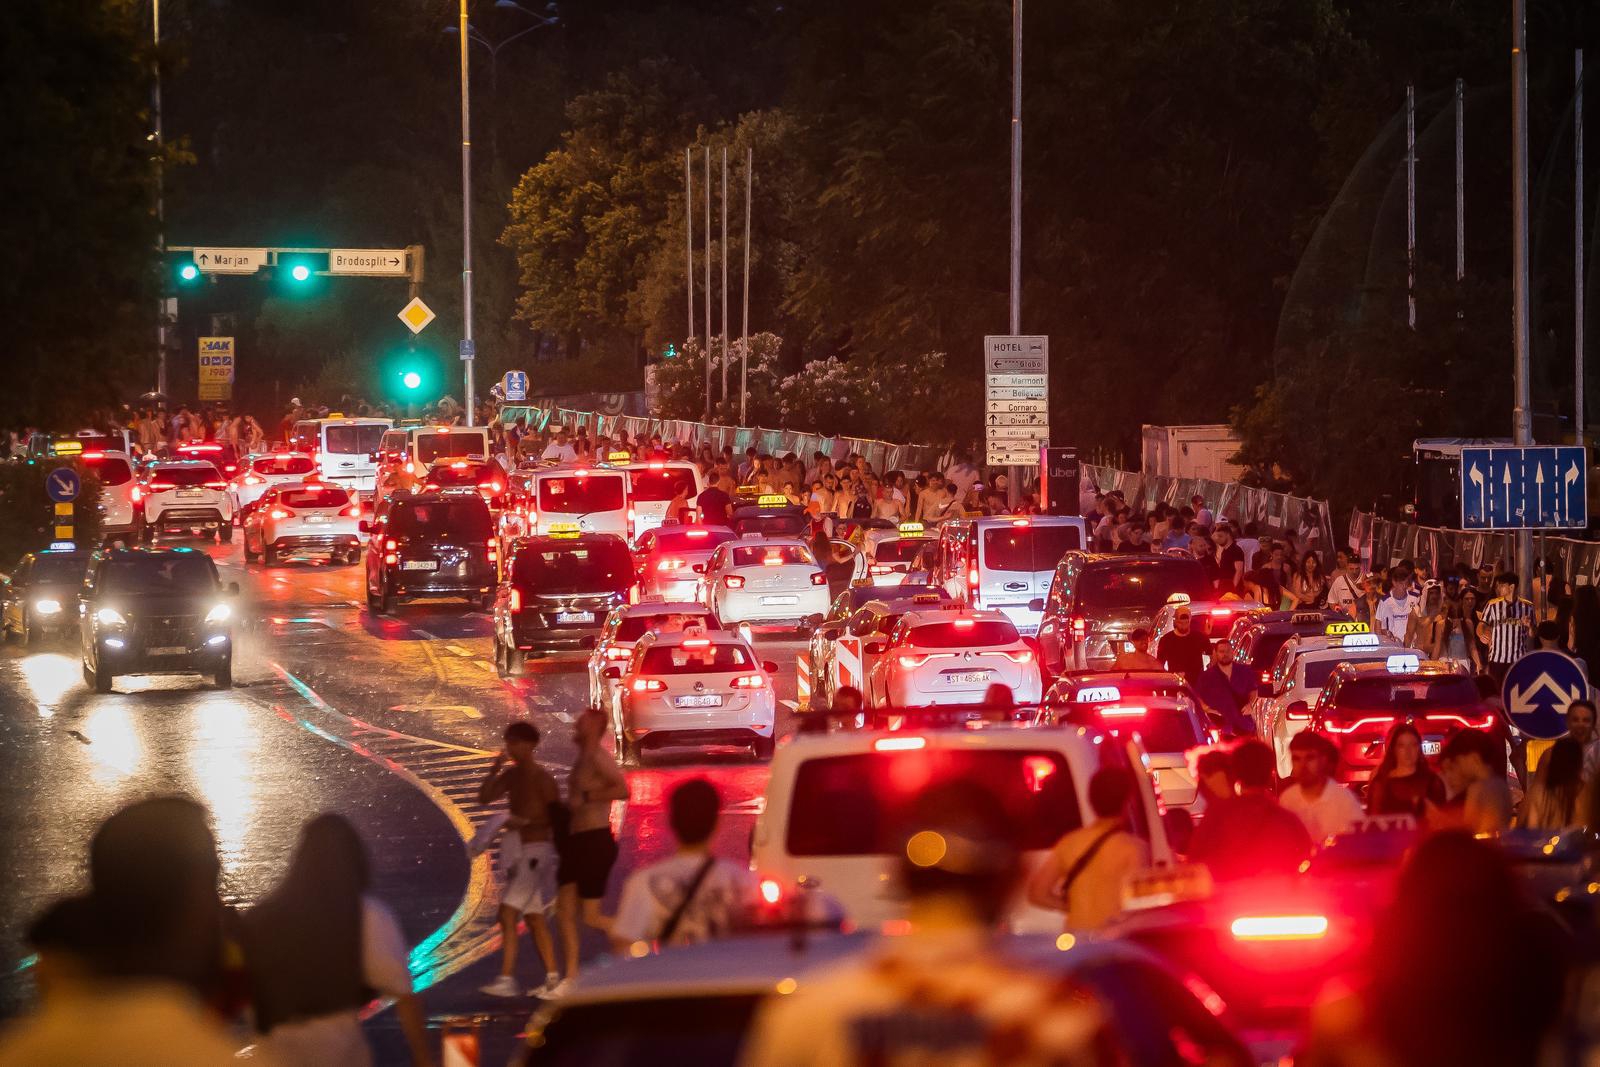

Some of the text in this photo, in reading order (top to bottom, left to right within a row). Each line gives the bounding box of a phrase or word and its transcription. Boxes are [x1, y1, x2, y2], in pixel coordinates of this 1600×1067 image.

[214, 255, 249, 268] Marjan
[336, 255, 387, 268] Brodosplit
[993, 343, 1022, 352] HOTEL
[1019, 360, 1041, 368] Globo
[209, 368, 232, 376] 1987
[1011, 377, 1044, 385] Marmont
[1012, 389, 1043, 397] Bellevue
[1008, 403, 1038, 412] Cornaro
[1330, 623, 1366, 633] TAXI
